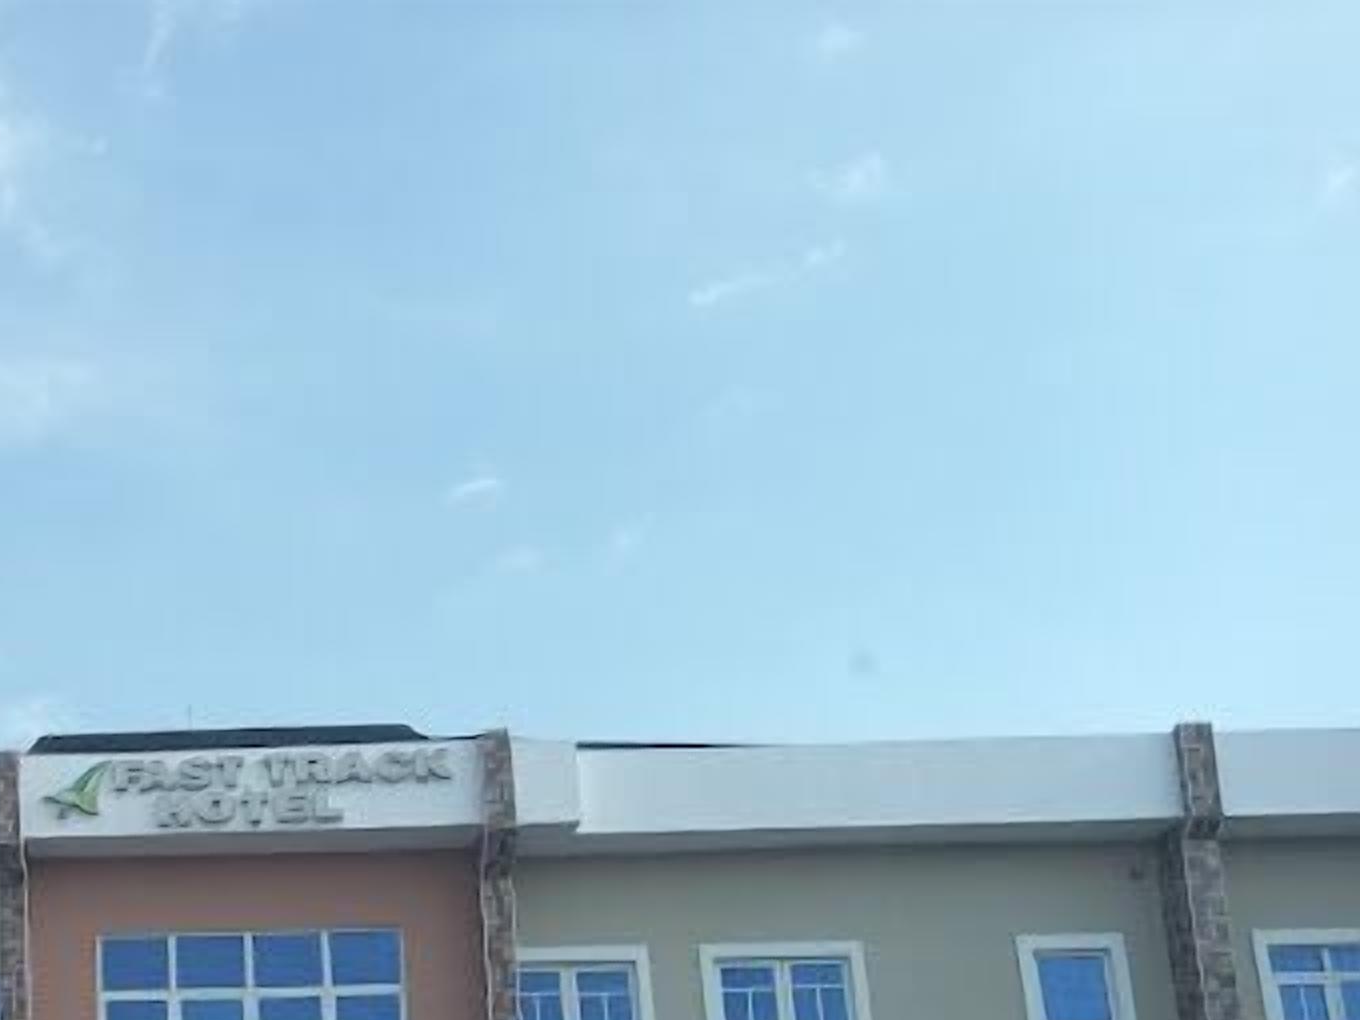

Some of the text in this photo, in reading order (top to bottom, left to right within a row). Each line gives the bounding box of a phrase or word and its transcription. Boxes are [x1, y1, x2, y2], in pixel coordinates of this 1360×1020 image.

[110, 748, 452, 793] FAST TRACK
[154, 791, 344, 829] HOTEL
